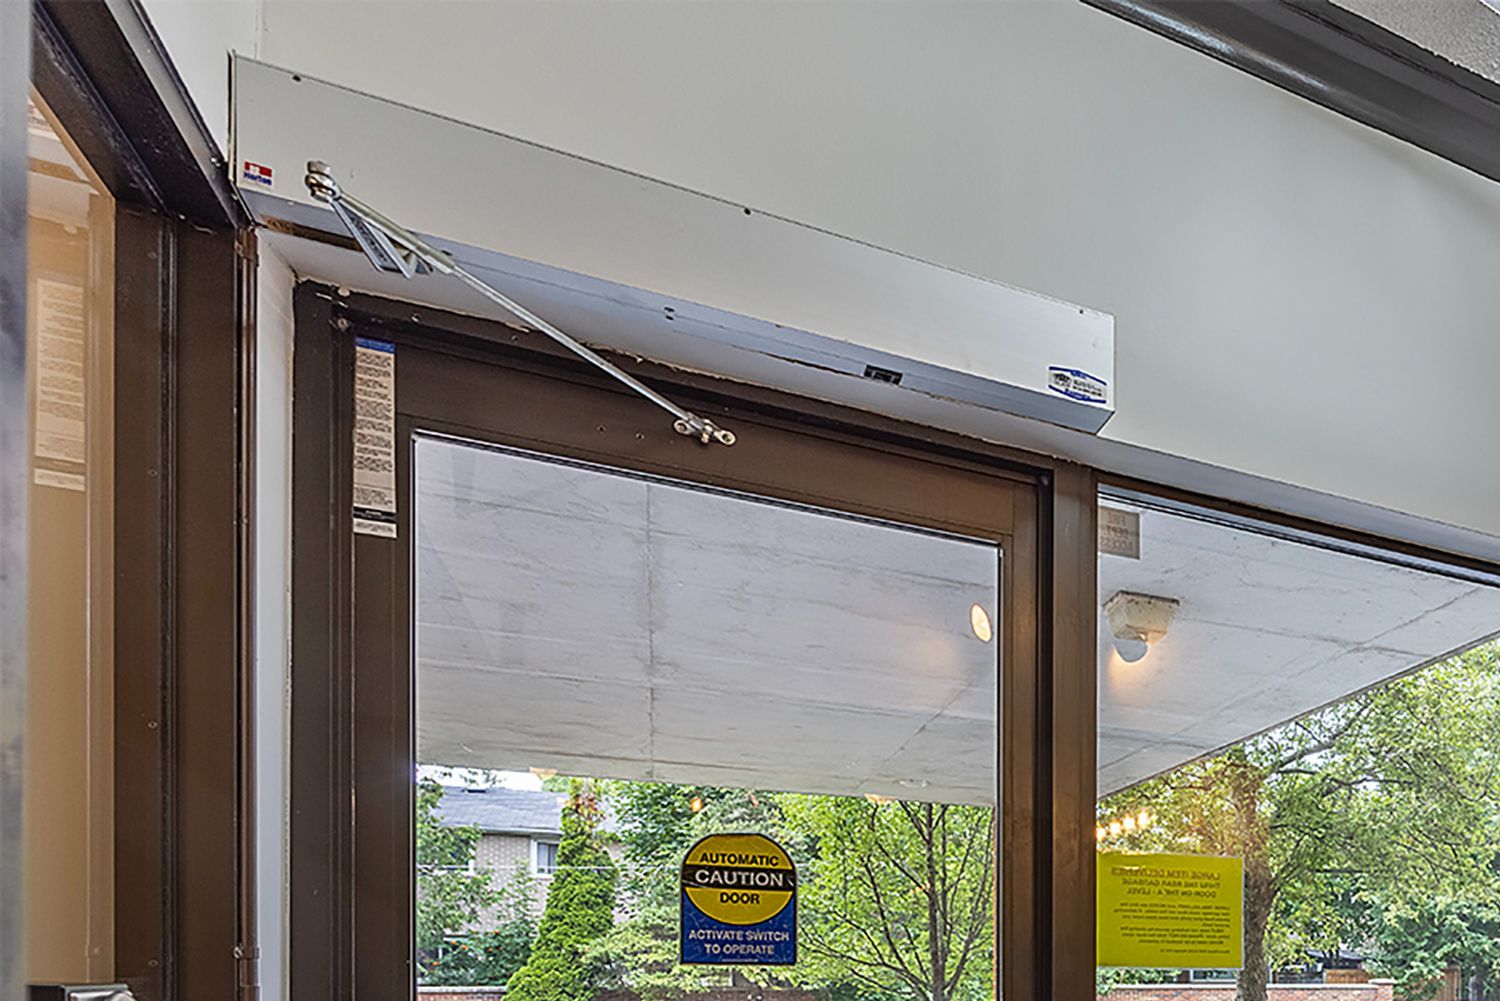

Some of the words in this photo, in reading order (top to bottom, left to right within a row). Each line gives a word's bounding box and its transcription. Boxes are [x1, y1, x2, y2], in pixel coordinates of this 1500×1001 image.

[699, 852, 779, 867] AUTOMATIC
[695, 869, 783, 887] CAUTION
[720, 892, 760, 904] DOOR
[688, 929, 743, 940] ACTIVATE
[745, 930, 789, 941] SWITCH
[704, 943, 720, 954] TO
[722, 944, 775, 954] OPERATE
